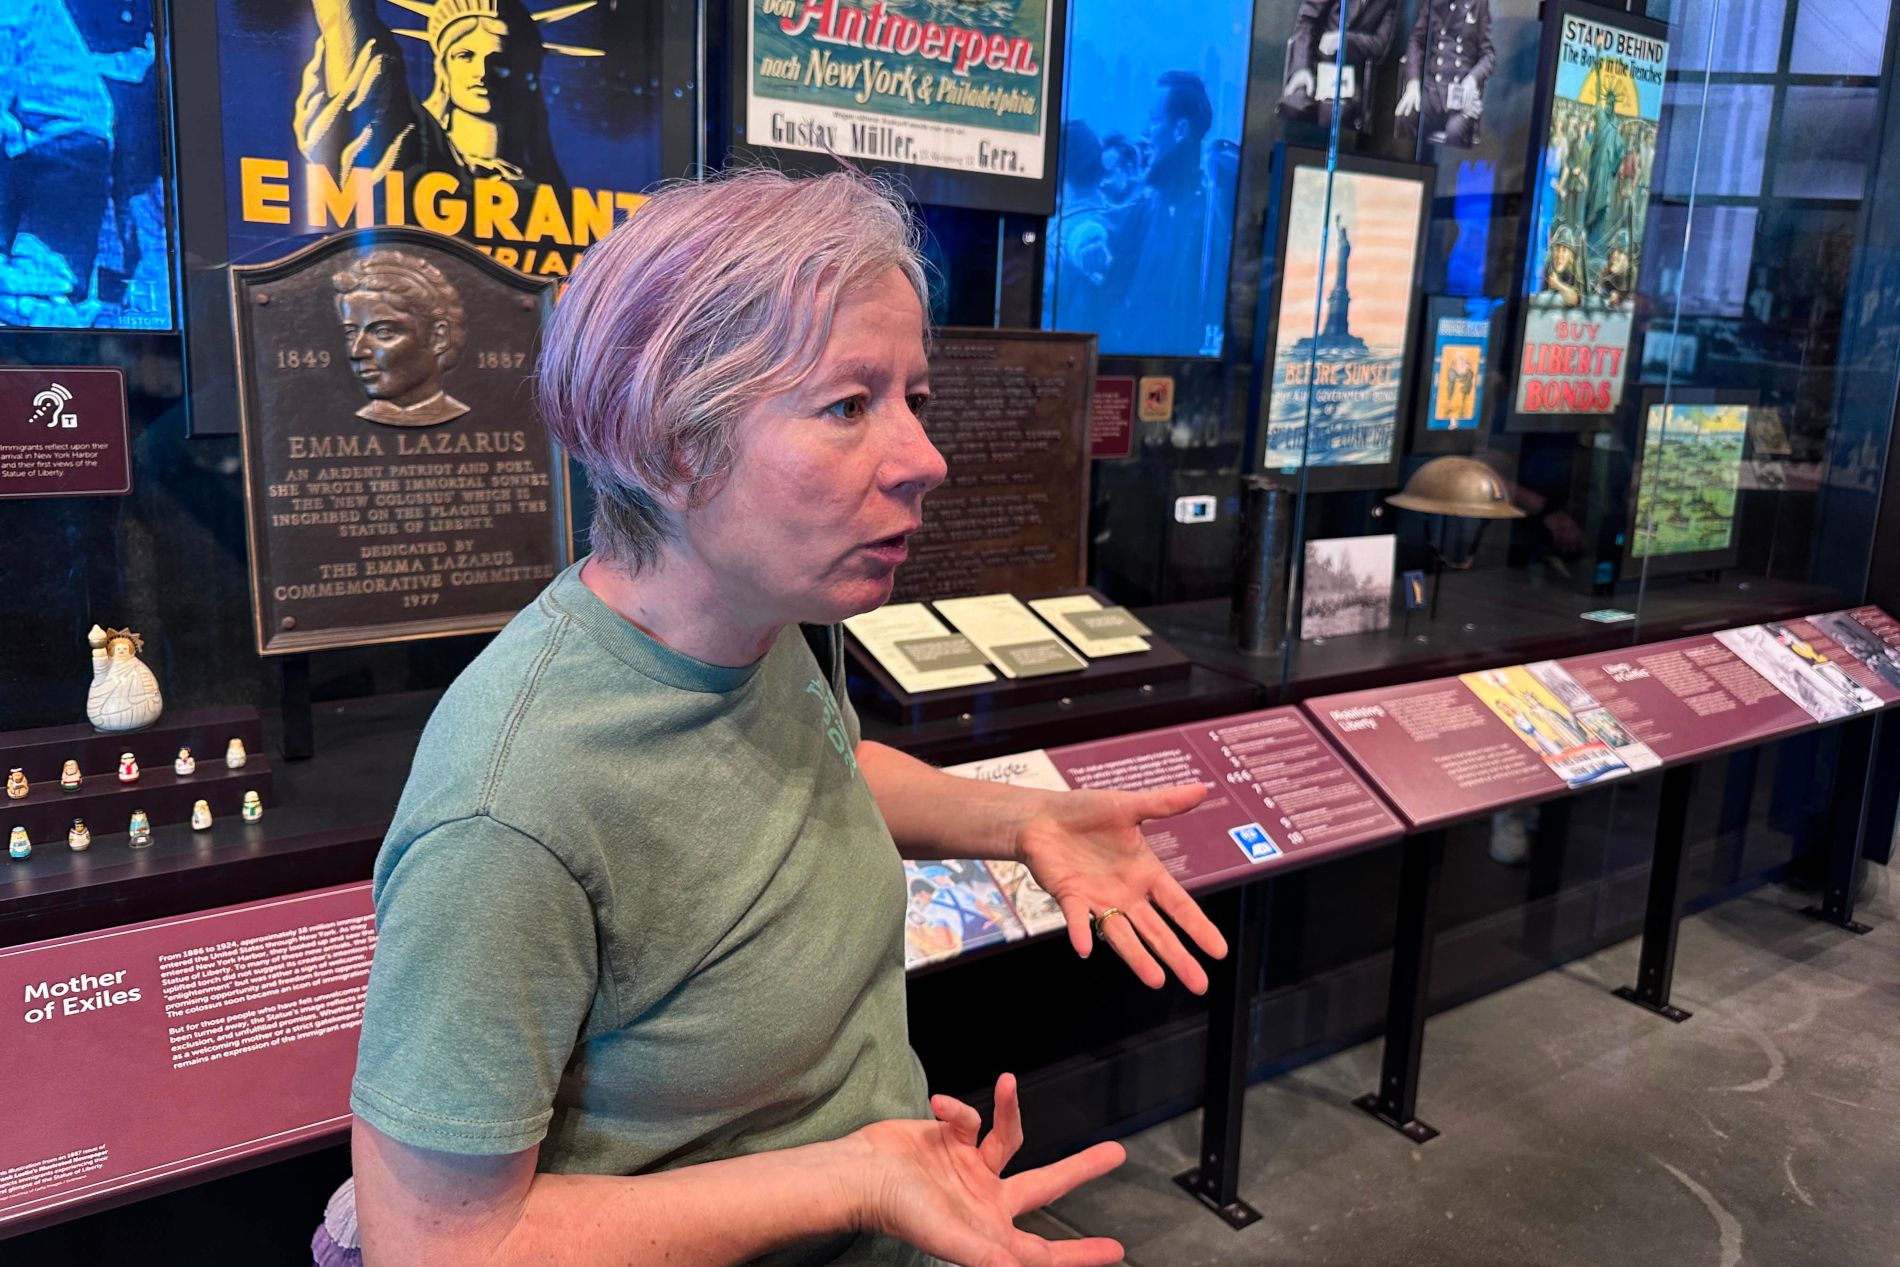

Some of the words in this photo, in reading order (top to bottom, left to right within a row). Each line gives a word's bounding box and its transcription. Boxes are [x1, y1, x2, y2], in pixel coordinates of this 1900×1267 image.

[1566, 21, 1613, 50] STAND
[1616, 33, 1663, 63] BEHIND
[1563, 43, 1578, 62] The
[1605, 56, 1614, 73] in
[1615, 59, 1628, 76] the
[1630, 61, 1662, 85] Trenches
[760, 56, 801, 80] nach
[803, 48, 862, 89] New
[855, 58, 917, 104] York
[917, 73, 934, 105] &
[935, 75, 1037, 117] Philadelphia
[851, 122, 917, 164] Müller,
[979, 140, 1024, 172] Gera.
[240, 157, 651, 247] EMIGRANT
[118, 315, 165, 325] HISTORY
[1556, 321, 1600, 341] BUY
[277, 351, 332, 369] 1849
[477, 352, 525, 369] 1887
[1523, 343, 1624, 377] LIBERTY
[1523, 379, 1611, 412] BONDS
[0, 444, 43, 453] Immigrants
[44, 443, 69, 451] reflect
[70, 444, 90, 452] upon
[1, 452, 23, 460] arrival
[72, 451, 98, 459] Harbor
[288, 434, 385, 459] EMMA
[397, 431, 526, 456] LAZARUS
[1, 470, 26, 478] Statue
[17, 461, 35, 469] their
[285, 469, 309, 481] AN
[317, 466, 385, 480] ARDENT
[390, 464, 453, 478] PATRIOT
[457, 462, 490, 475] AND
[268, 483, 300, 497] SHE
[306, 480, 364, 495] WROTE
[369, 480, 400, 492] THE
[405, 476, 486, 491] IMMORTAL
[291, 498, 324, 511] THE
[461, 488, 512, 502] WHICH
[272, 511, 361, 527] INSCRIBED
[368, 508, 389, 521] ON
[395, 506, 424, 520] THE
[430, 503, 490, 518] PLAQUE
[495, 502, 512, 515] IN
[518, 500, 548, 513] THE
[340, 522, 399, 537] STATUE
[404, 520, 424, 533] OF
[361, 541, 448, 559] DEDICATED
[455, 539, 474, 553] BY
[320, 562, 358, 579] THE
[366, 557, 425, 576] EMMA
[431, 550, 514, 571] LAZARUS
[274, 574, 443, 600] COMMEMORATIVE
[451, 564, 554, 587] COMMITTEE
[403, 592, 441, 609] 1977
[158, 953, 181, 961] From
[183, 947, 204, 956] 1886
[240, 930, 296, 945] approximately
[159, 958, 192, 969] entered
[210, 948, 237, 958] United
[239, 944, 263, 953] States
[265, 937, 297, 947] through
[160, 965, 194, 977] entered
[195, 962, 214, 970] New
[216, 957, 235, 965] York
[162, 976, 189, 985] Statue
[247, 959, 269, 967] many
[163, 981, 196, 993] uplifted
[197, 977, 220, 986] torch
[222, 972, 235, 980] did
[253, 963, 284, 974] suggest
[24, 969, 127, 1003] Mother
[165, 996, 208, 1010] promising
[210, 985, 259, 999] opportunity
[261, 980, 276, 988] and
[234, 978, 248, 986] but
[24, 1001, 55, 1023] of
[63, 987, 142, 1016] Exiles
[185, 1001, 222, 1013] colossus
[223, 996, 244, 1005] soon
[246, 989, 279, 1000] became
[169, 1026, 184, 1034] But
[200, 1018, 224, 1026] those
[226, 1010, 255, 1022] people
[257, 1006, 276, 1014] who
[170, 1034, 192, 1042] been
[194, 1025, 222, 1037] turned
[266, 1009, 298, 1020] Statue's
[216, 1032, 233, 1040] and
[234, 1021, 277, 1036] unfulfilled
[173, 1056, 208, 1068] remains
[223, 1042, 268, 1056] expression
[297, 1024, 338, 1038] immigrant
[191, 1040, 239, 1055] welcoming
[241, 1032, 272, 1043] mother
